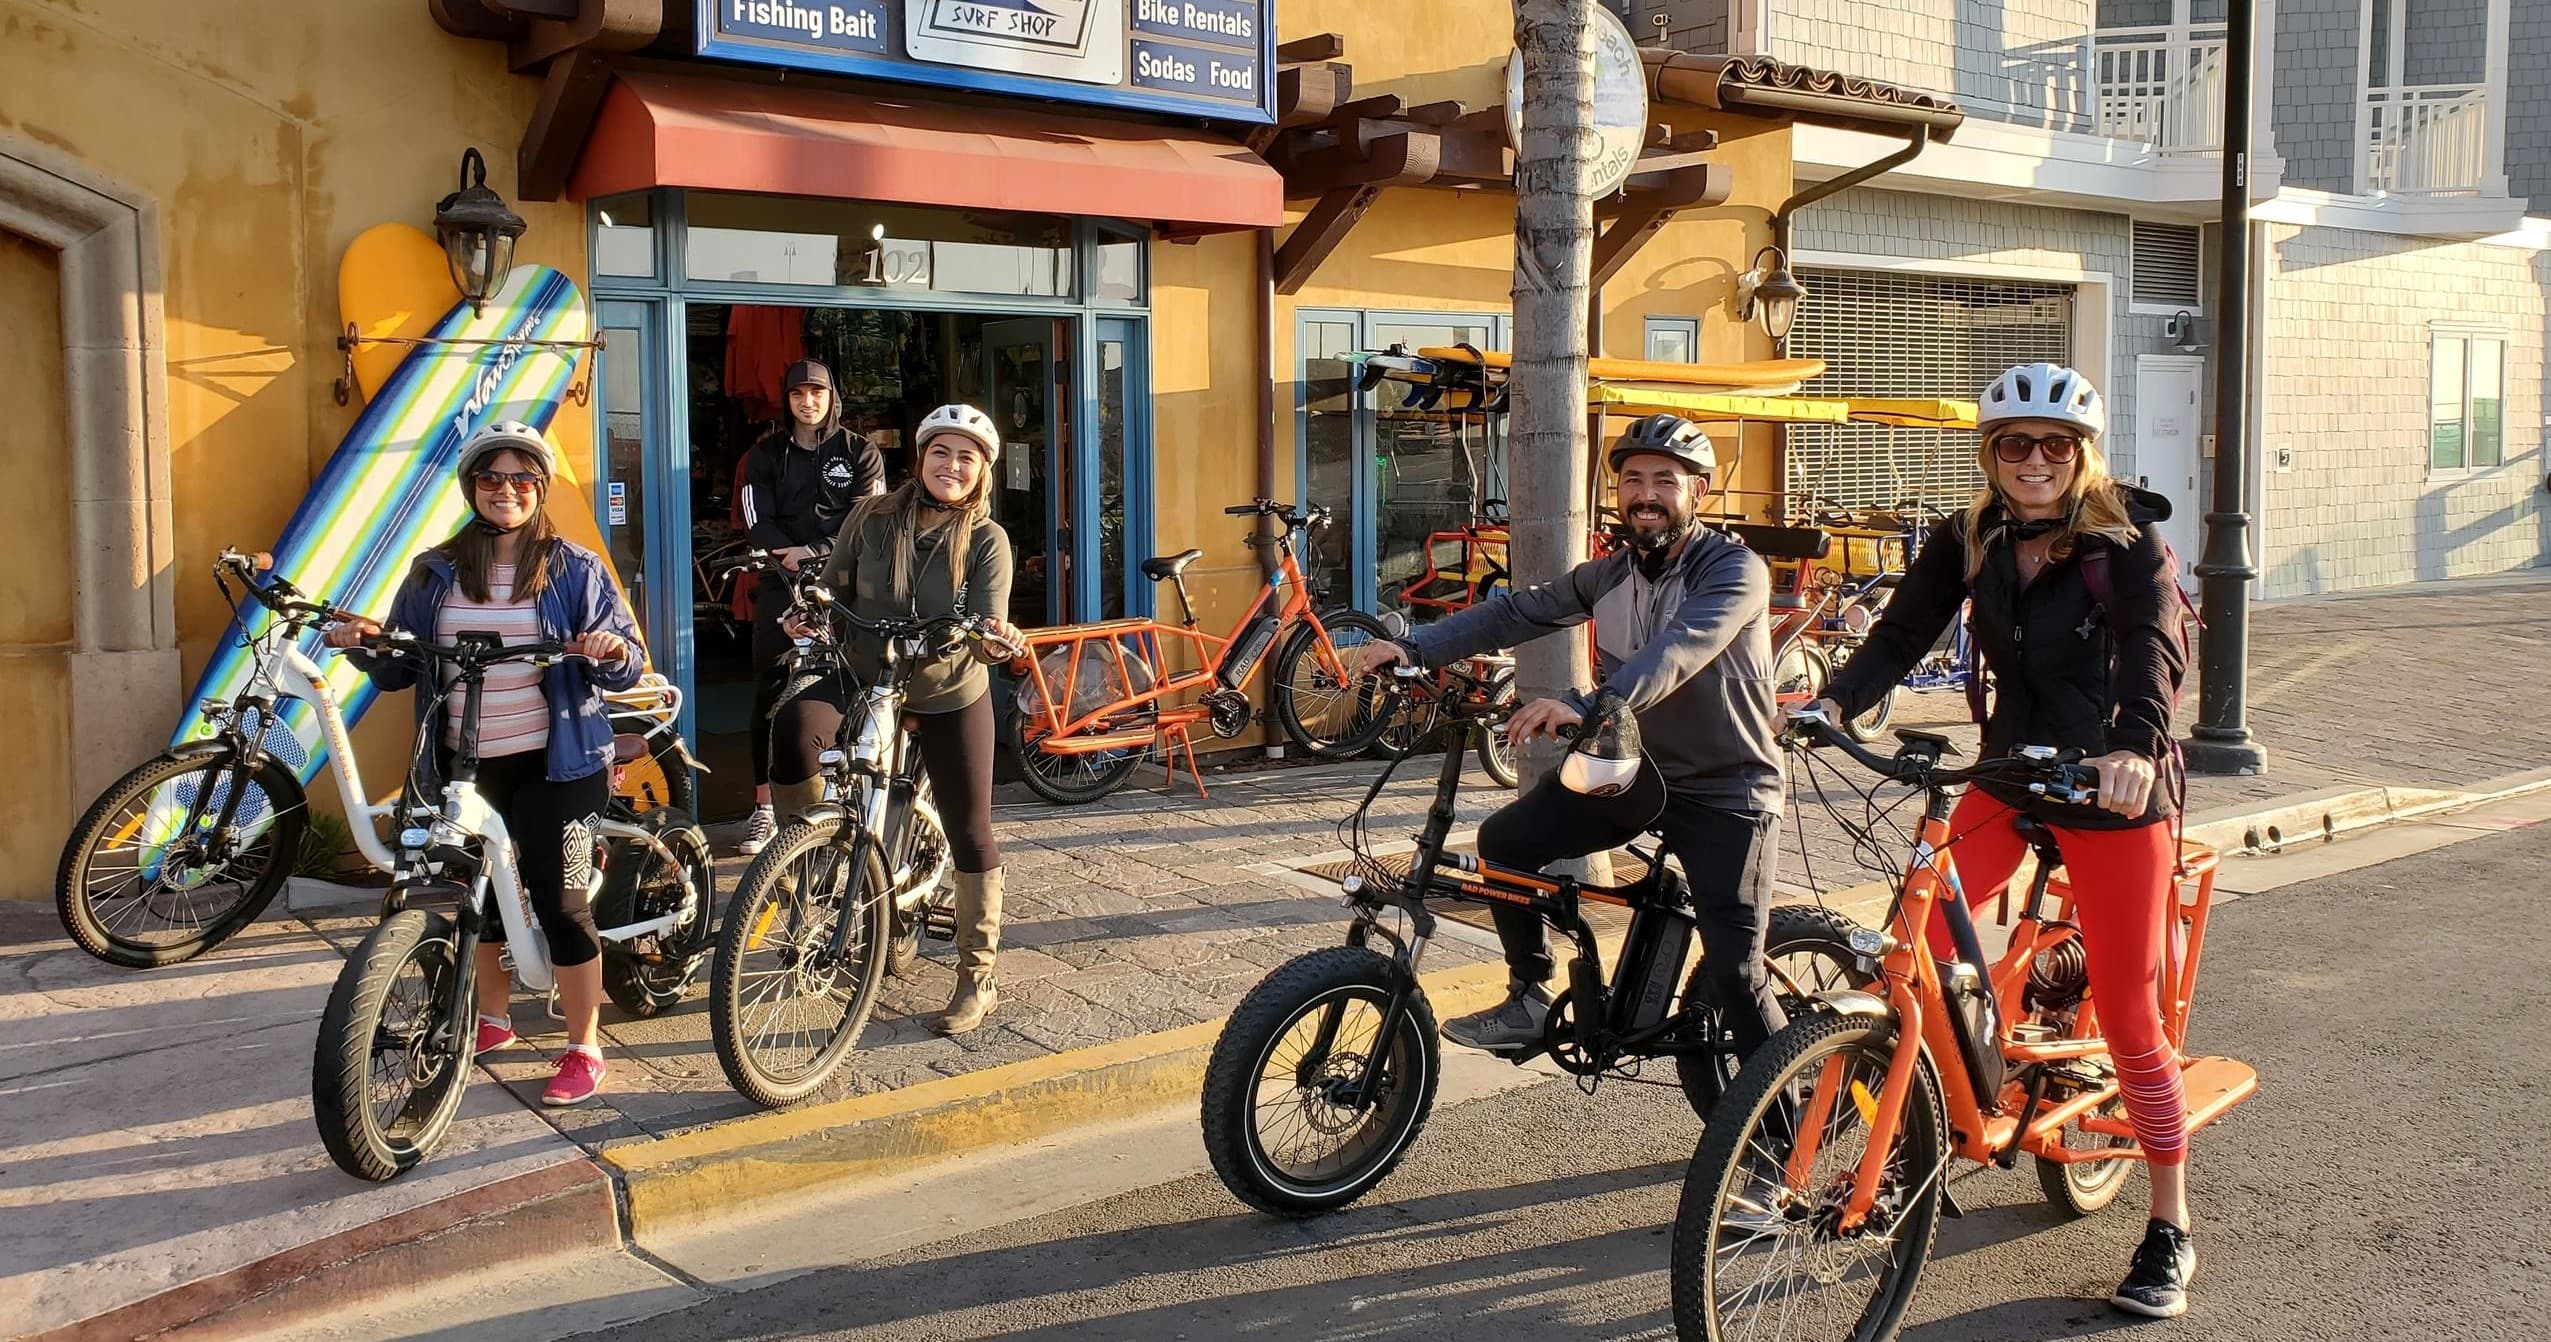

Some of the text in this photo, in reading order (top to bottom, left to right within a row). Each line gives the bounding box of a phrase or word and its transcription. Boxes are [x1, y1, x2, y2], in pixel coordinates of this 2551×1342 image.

[734, 0, 876, 39] Fishing Bait
[952, 6, 1056, 37] SURF SHOP
[1138, 0, 1252, 38] Bike Rentals
[1138, 51, 1252, 90] Sodas Food
[1599, 28, 1631, 77] each
[1592, 146, 1629, 187] ntals
[862, 248, 929, 284] 102
[1235, 657, 1251, 677] RAD
[1461, 882, 1531, 905] RAD POWER BIKES
